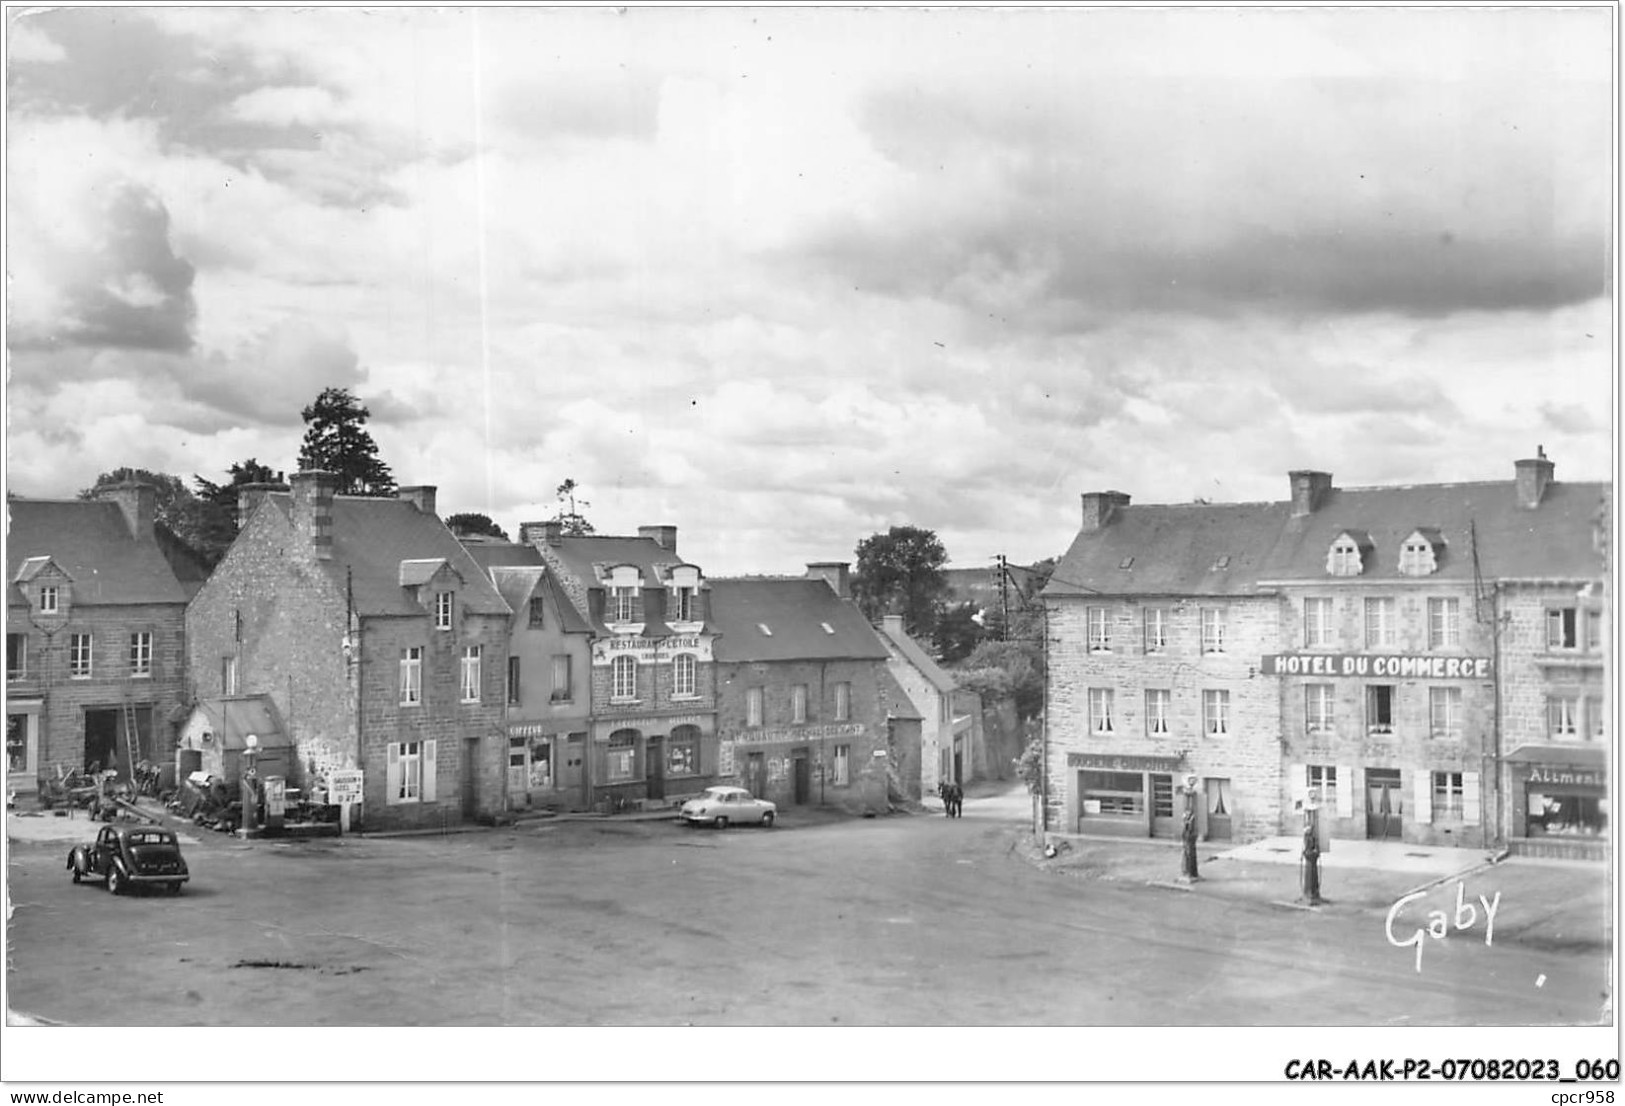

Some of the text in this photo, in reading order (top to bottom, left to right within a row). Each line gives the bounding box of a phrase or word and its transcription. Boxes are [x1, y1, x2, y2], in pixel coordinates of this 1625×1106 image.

[1275, 656, 1489, 678] HOTEL DU COMMERCE
